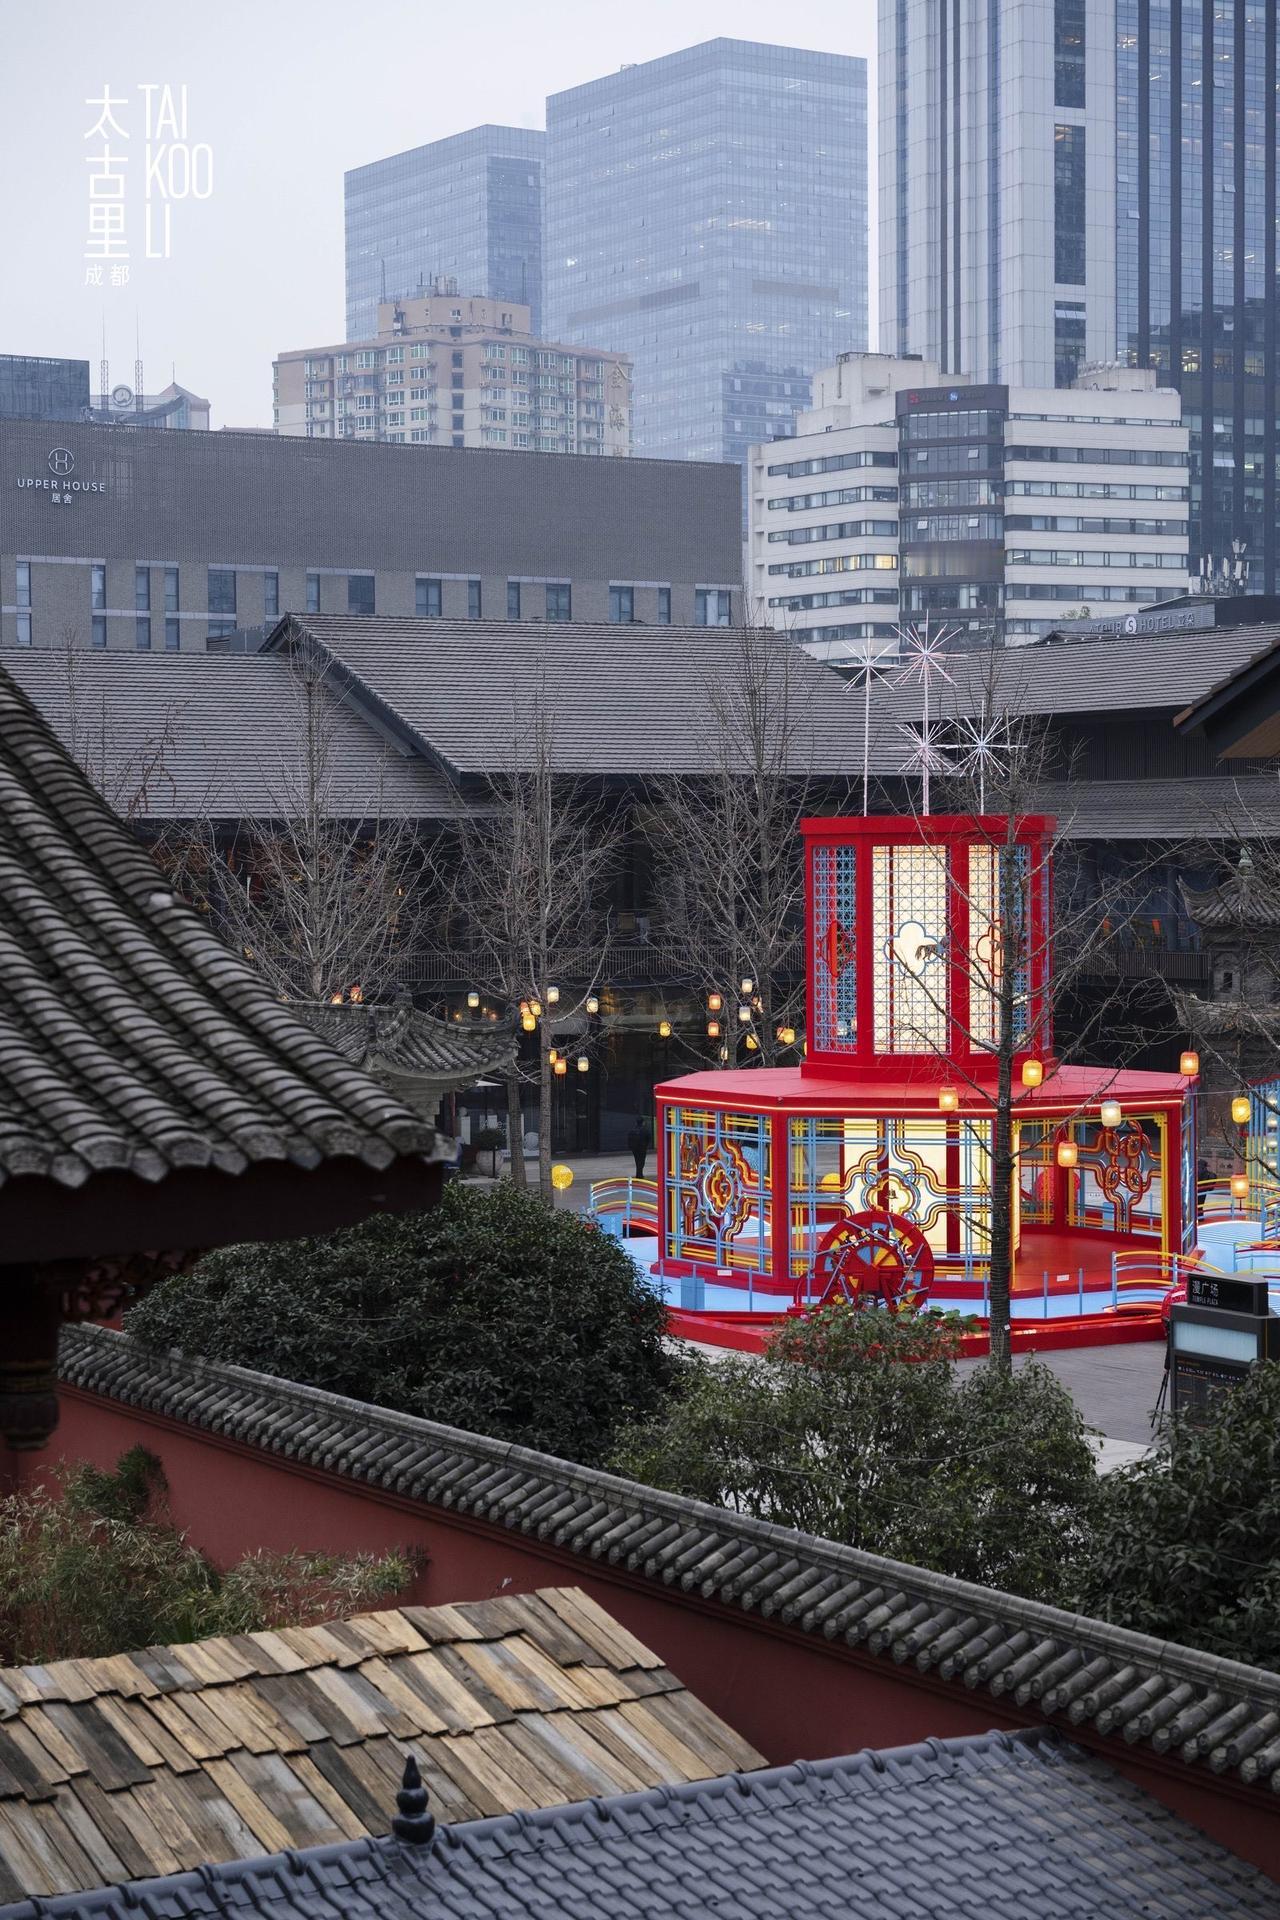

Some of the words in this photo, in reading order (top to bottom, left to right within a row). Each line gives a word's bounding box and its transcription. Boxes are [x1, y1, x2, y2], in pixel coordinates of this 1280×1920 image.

[17, 478, 58, 490] UPPER
[63, 481, 106, 492] HOUSE
[51, 493, 73, 504] 居舍
[1140, 616, 1175, 633] HOTEL
